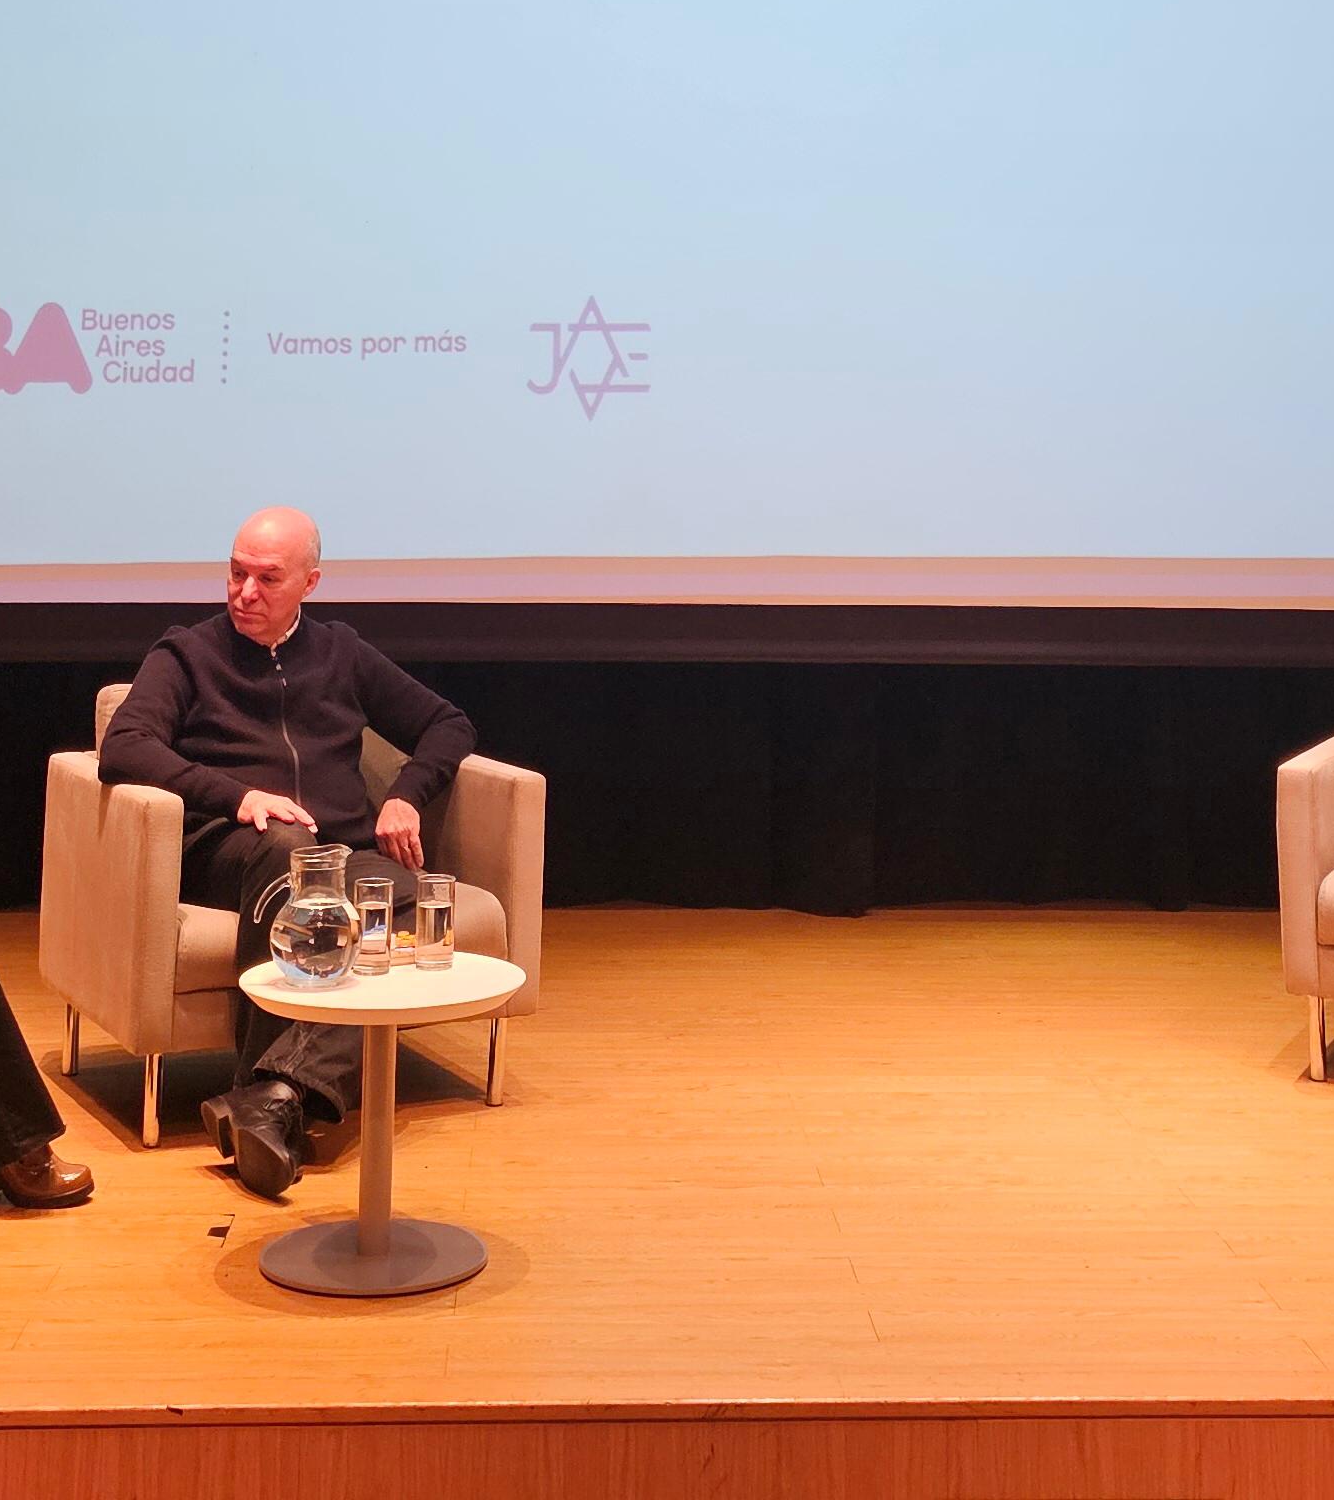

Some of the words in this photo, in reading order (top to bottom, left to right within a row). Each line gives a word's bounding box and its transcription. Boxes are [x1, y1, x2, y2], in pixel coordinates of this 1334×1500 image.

[80, 307, 176, 332] Buenos
[94, 333, 166, 358] Aires
[266, 331, 353, 356] Vamos
[360, 334, 408, 361] por
[414, 328, 468, 355] más
[101, 357, 196, 384] Ciudad
